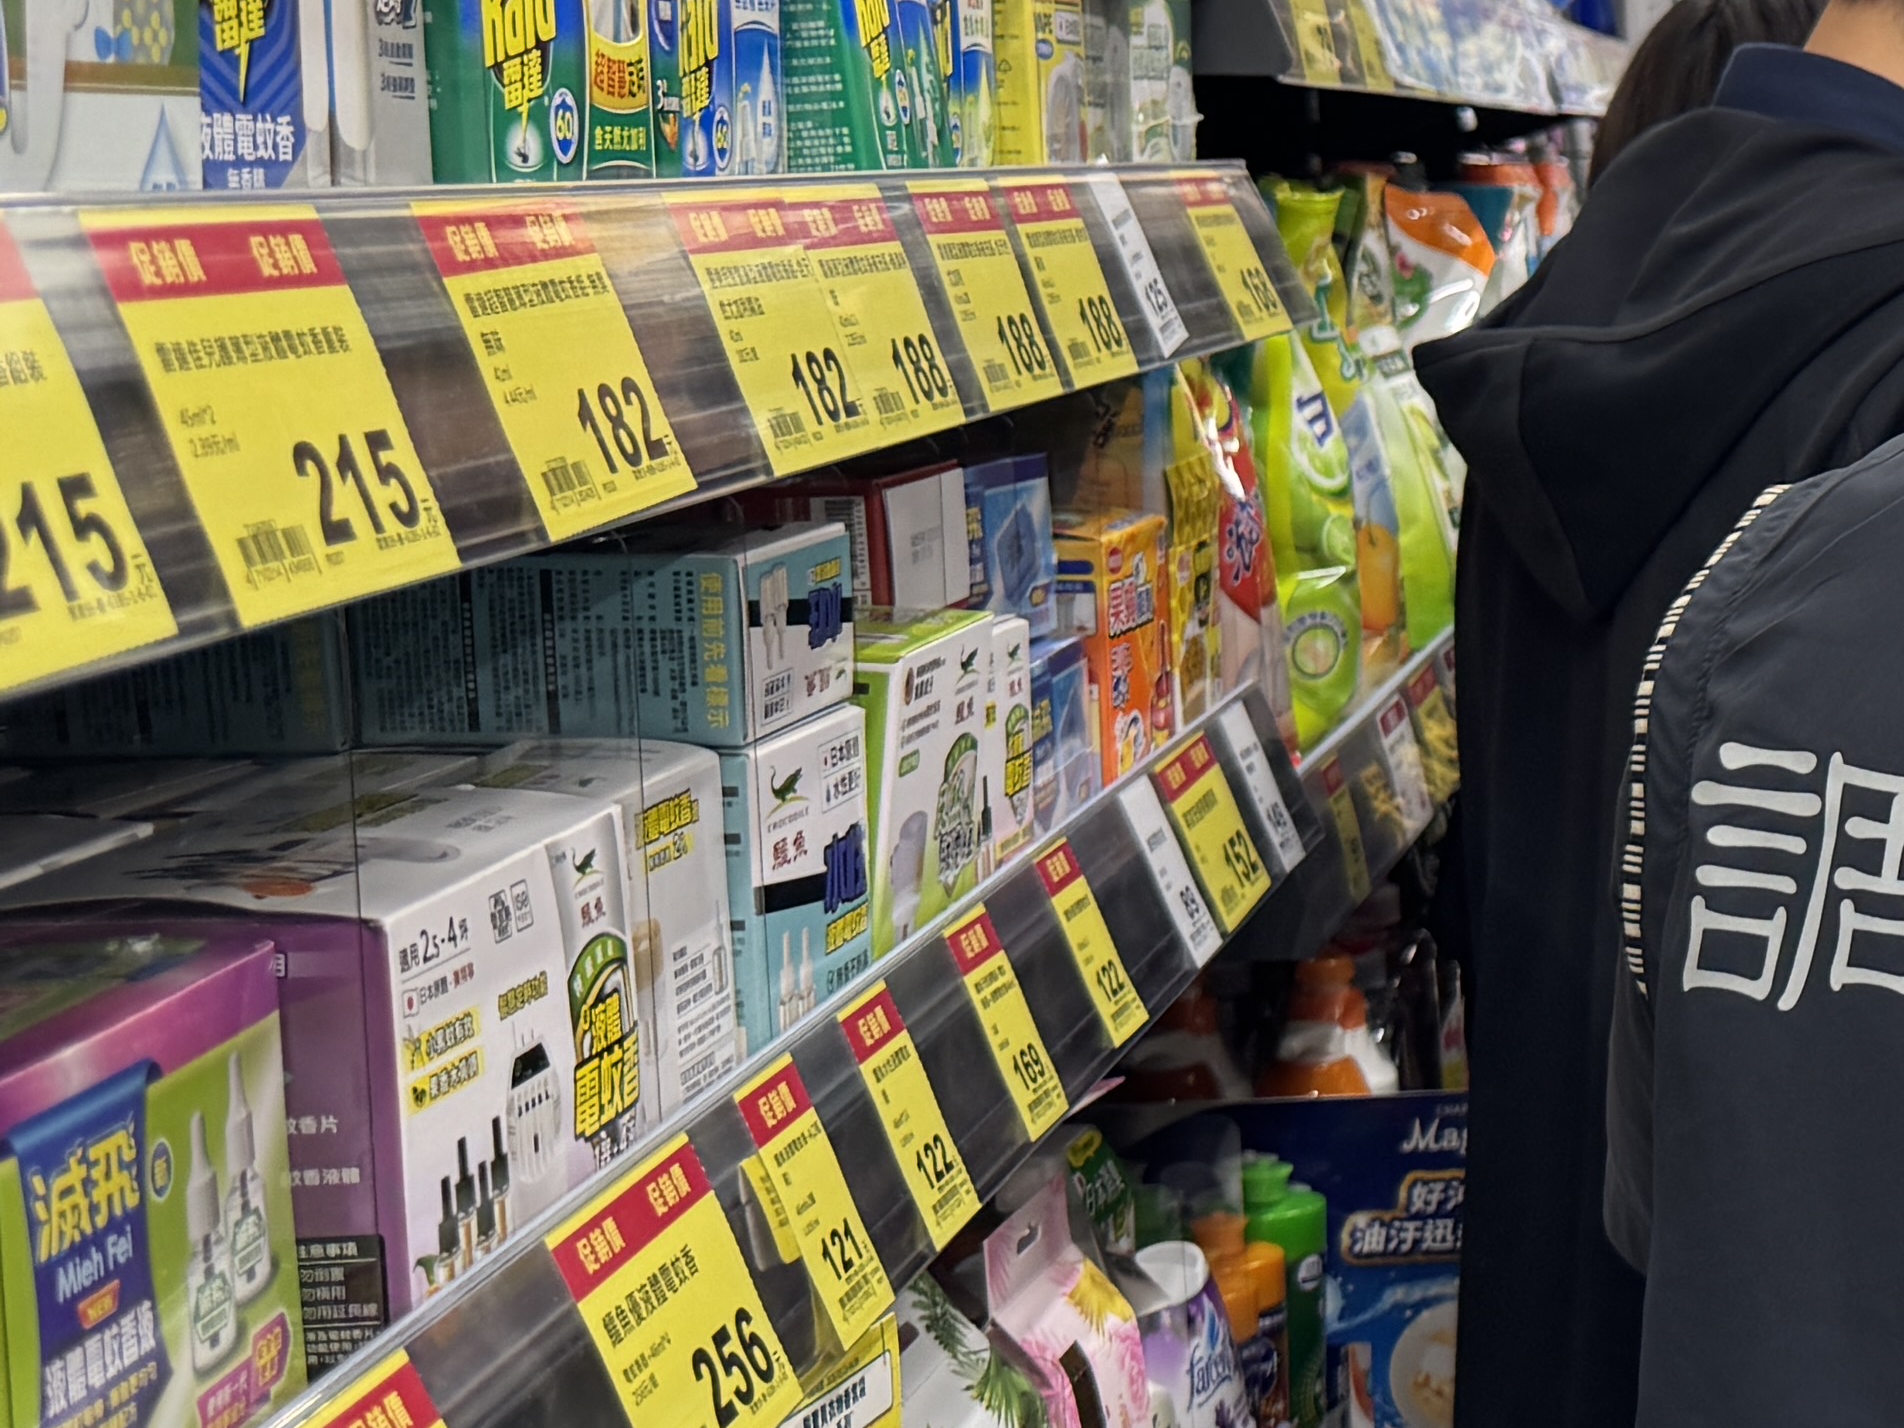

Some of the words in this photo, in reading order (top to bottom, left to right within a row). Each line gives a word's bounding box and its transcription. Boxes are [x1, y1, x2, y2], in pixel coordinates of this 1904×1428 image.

[554, 106, 575, 143] 60
[996, 312, 1047, 376] 188
[1078, 294, 1123, 353] 188
[790, 347, 861, 426] 182
[890, 333, 949, 405] 188
[577, 376, 670, 475] 182
[1012, 1042, 1046, 1091] 169
[915, 1133, 955, 1190] 122
[57, 1239, 106, 1303] Mieh
[109, 1225, 135, 1268] Fei
[821, 1217, 863, 1281] 121
